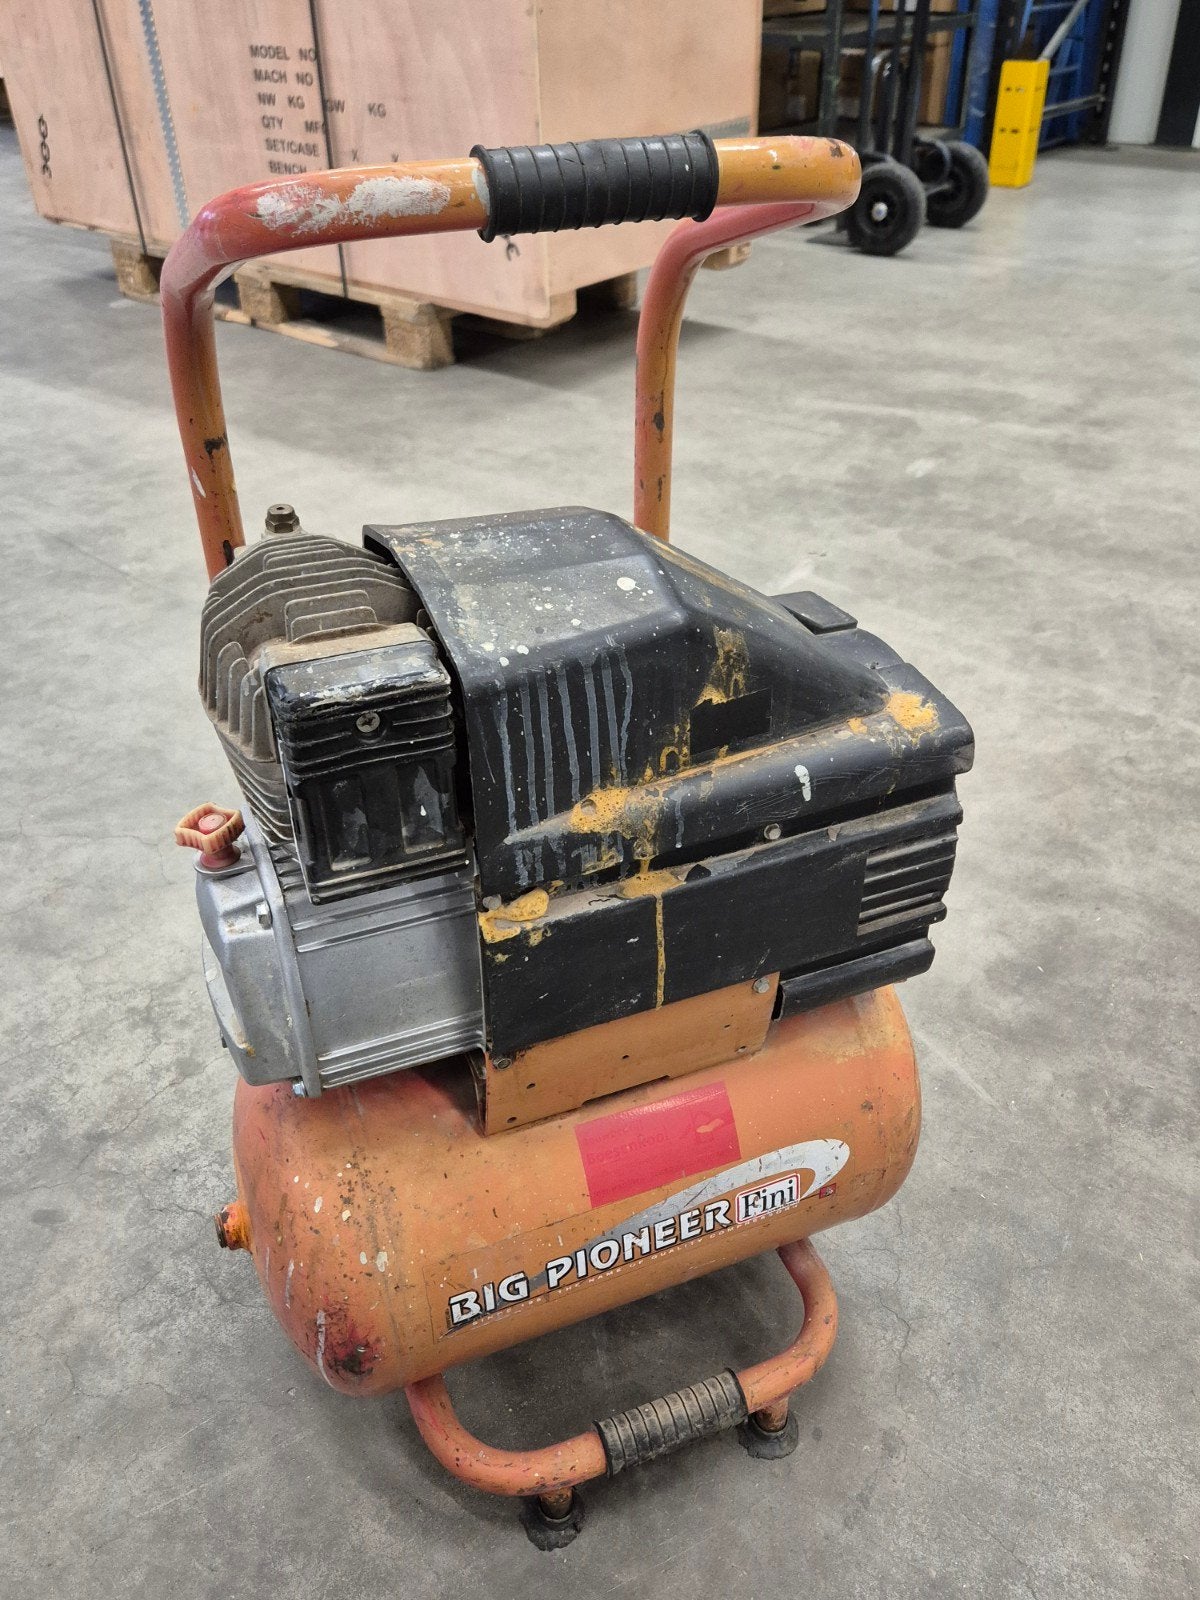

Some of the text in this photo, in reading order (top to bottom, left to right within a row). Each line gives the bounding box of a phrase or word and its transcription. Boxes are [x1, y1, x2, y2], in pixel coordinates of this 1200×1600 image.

[250, 45, 316, 62] MODEL NO
[254, 69, 313, 87] MACH NO
[288, 95, 305, 110] KG
[368, 103, 387, 118] KG
[262, 115, 283, 130] QTY
[269, 160, 307, 175] BENCH
[741, 1178, 796, 1220] Fini
[449, 1199, 734, 1325] BIG PIONEER
